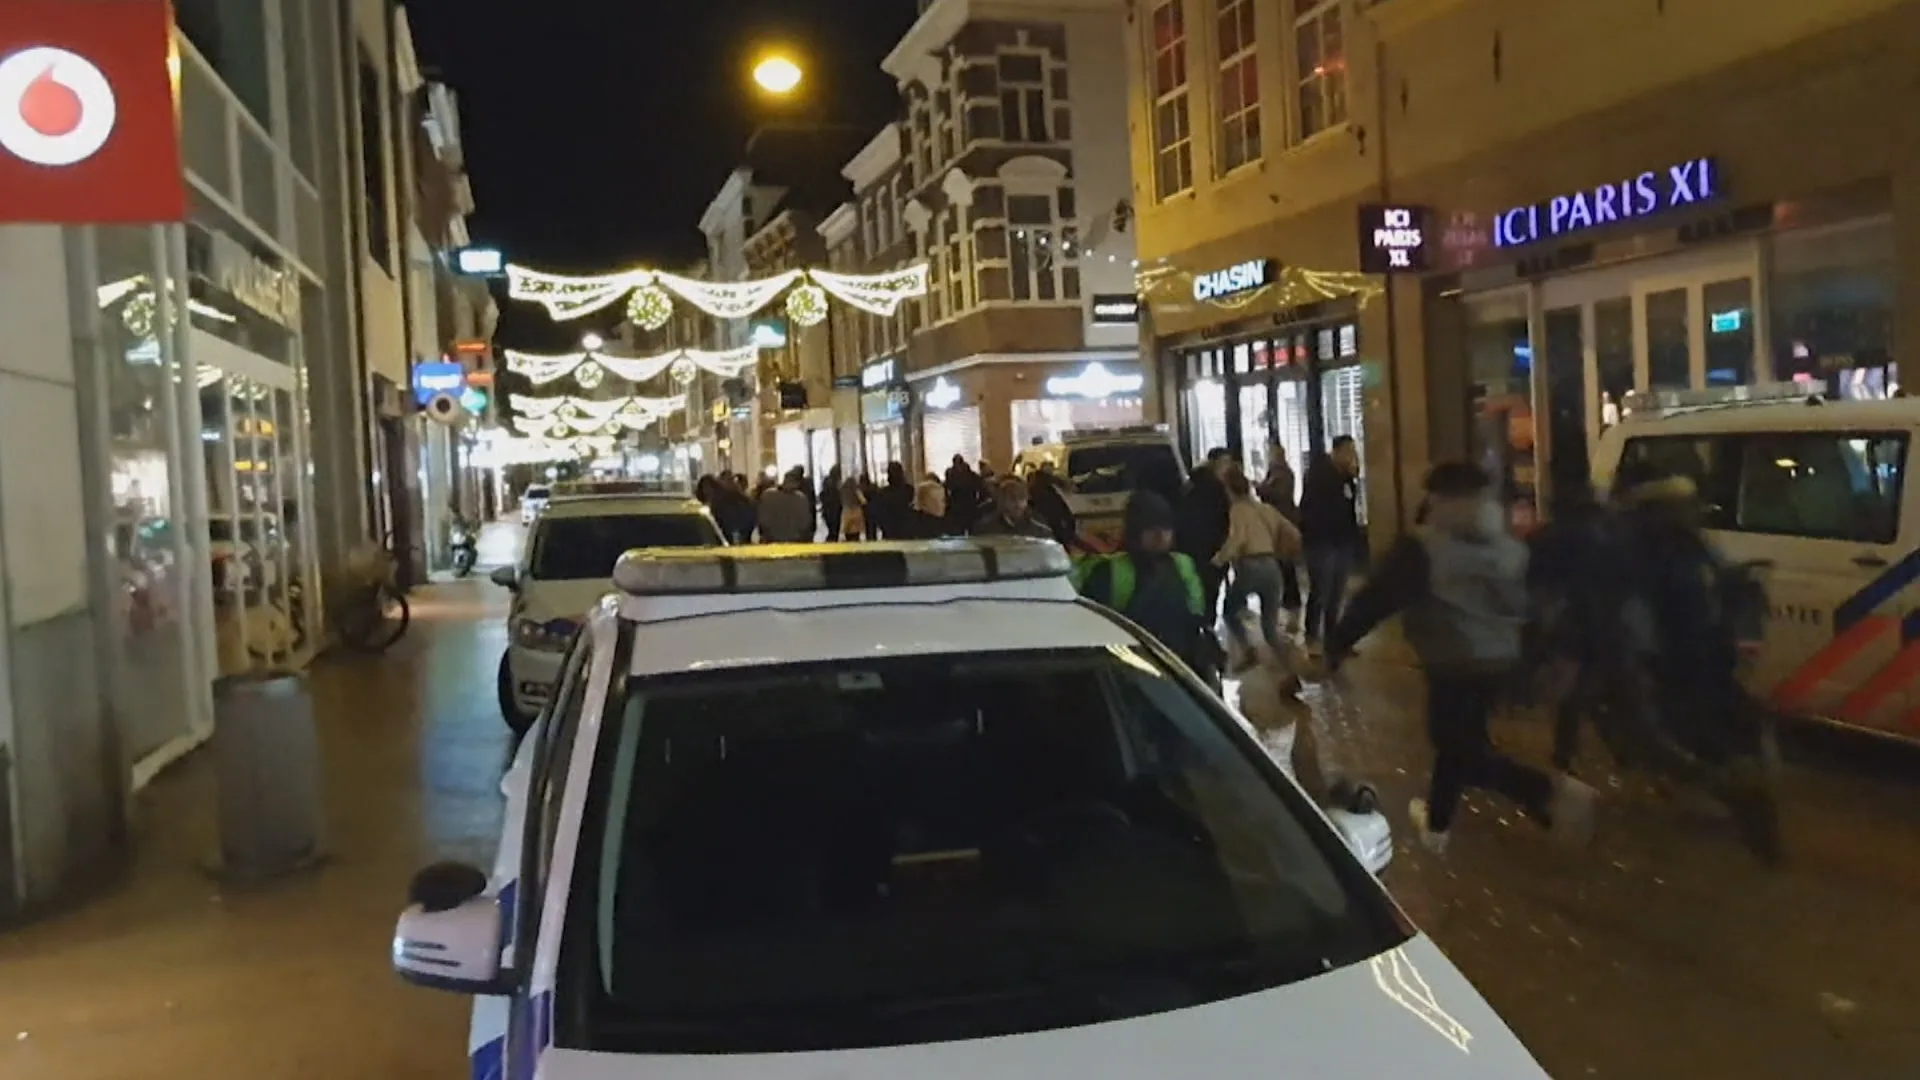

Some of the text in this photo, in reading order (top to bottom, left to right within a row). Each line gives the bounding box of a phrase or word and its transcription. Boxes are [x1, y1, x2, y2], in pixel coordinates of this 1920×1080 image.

[1494, 204, 1537, 247] ICI
[1549, 170, 1657, 234] PARIS
[1384, 209, 1411, 228] ICI
[1373, 229, 1422, 248] PARIS
[1387, 249, 1411, 267] XL
